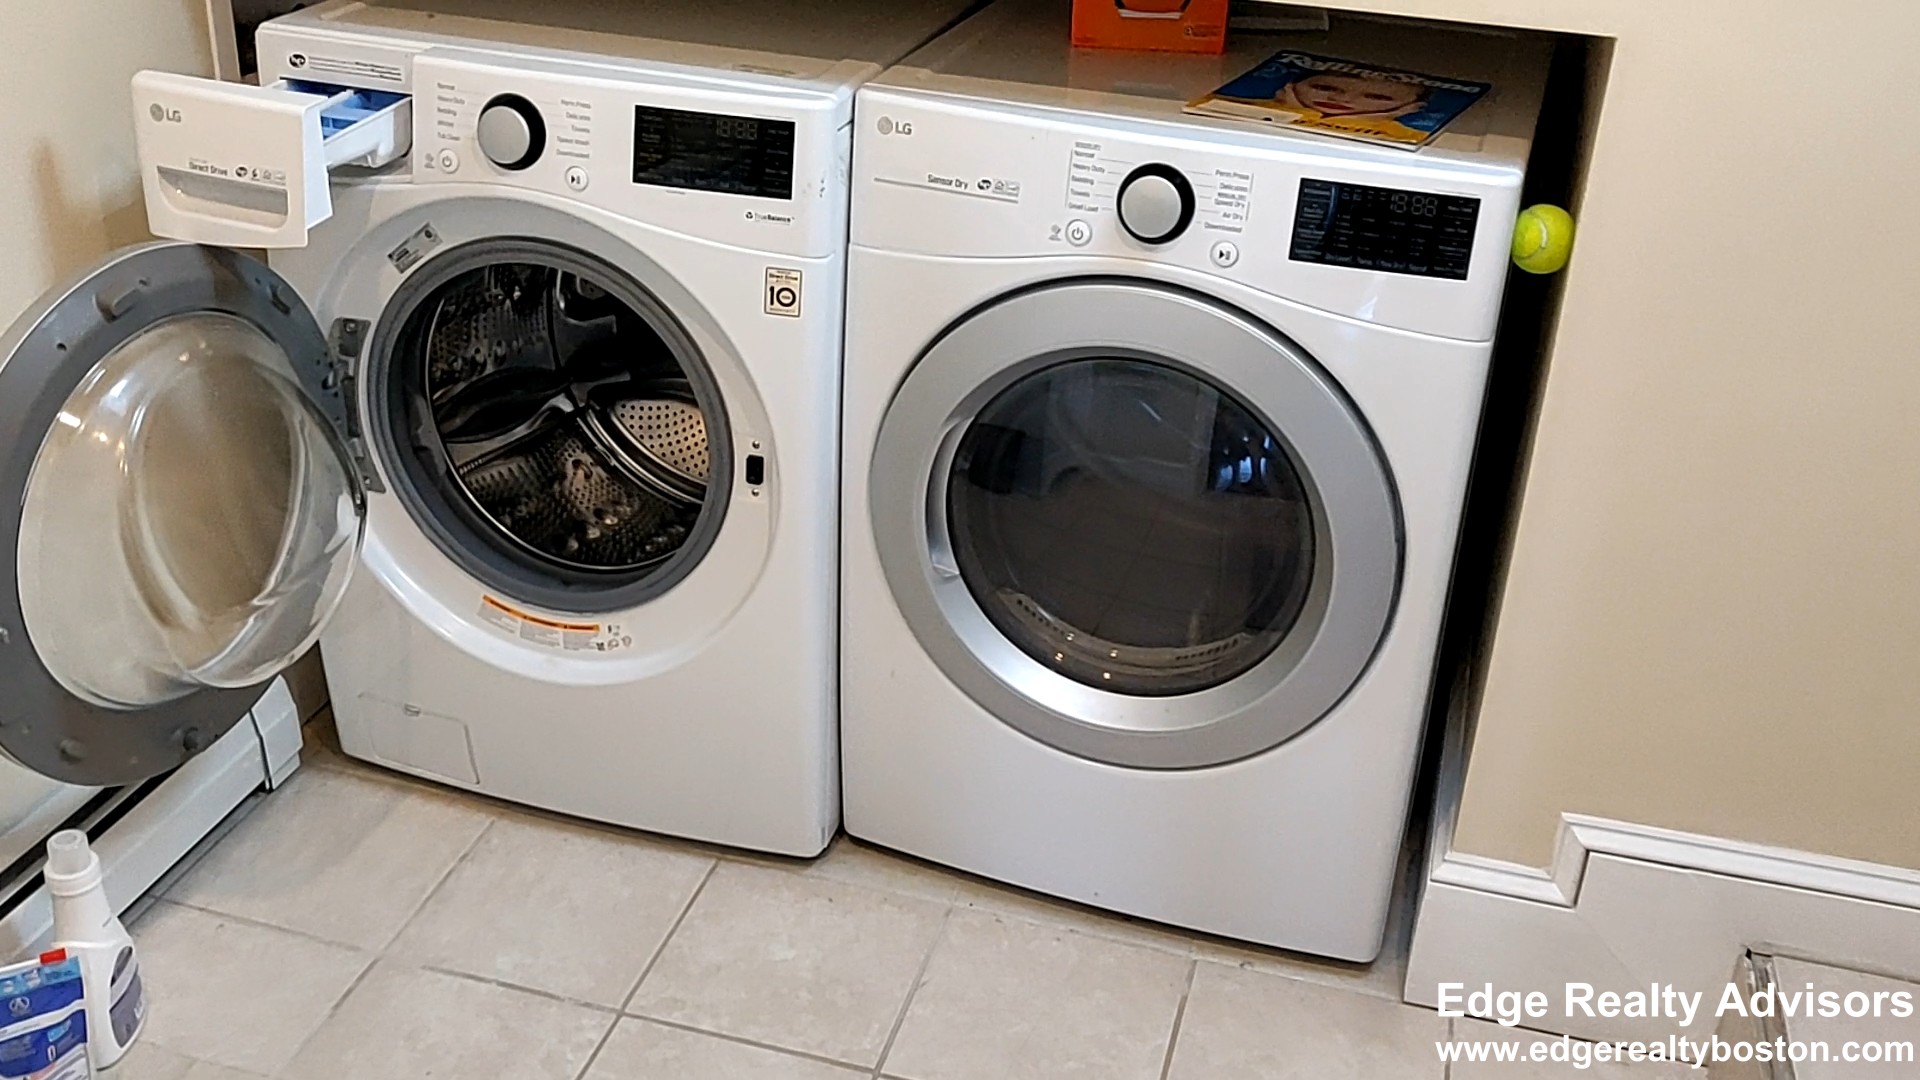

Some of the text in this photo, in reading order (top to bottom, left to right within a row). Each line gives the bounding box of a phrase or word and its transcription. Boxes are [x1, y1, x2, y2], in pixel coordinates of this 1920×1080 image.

[166, 108, 182, 123] LG
[895, 121, 913, 135] LG
[928, 173, 968, 190] Sensor Dry
[769, 285, 797, 308] 10
